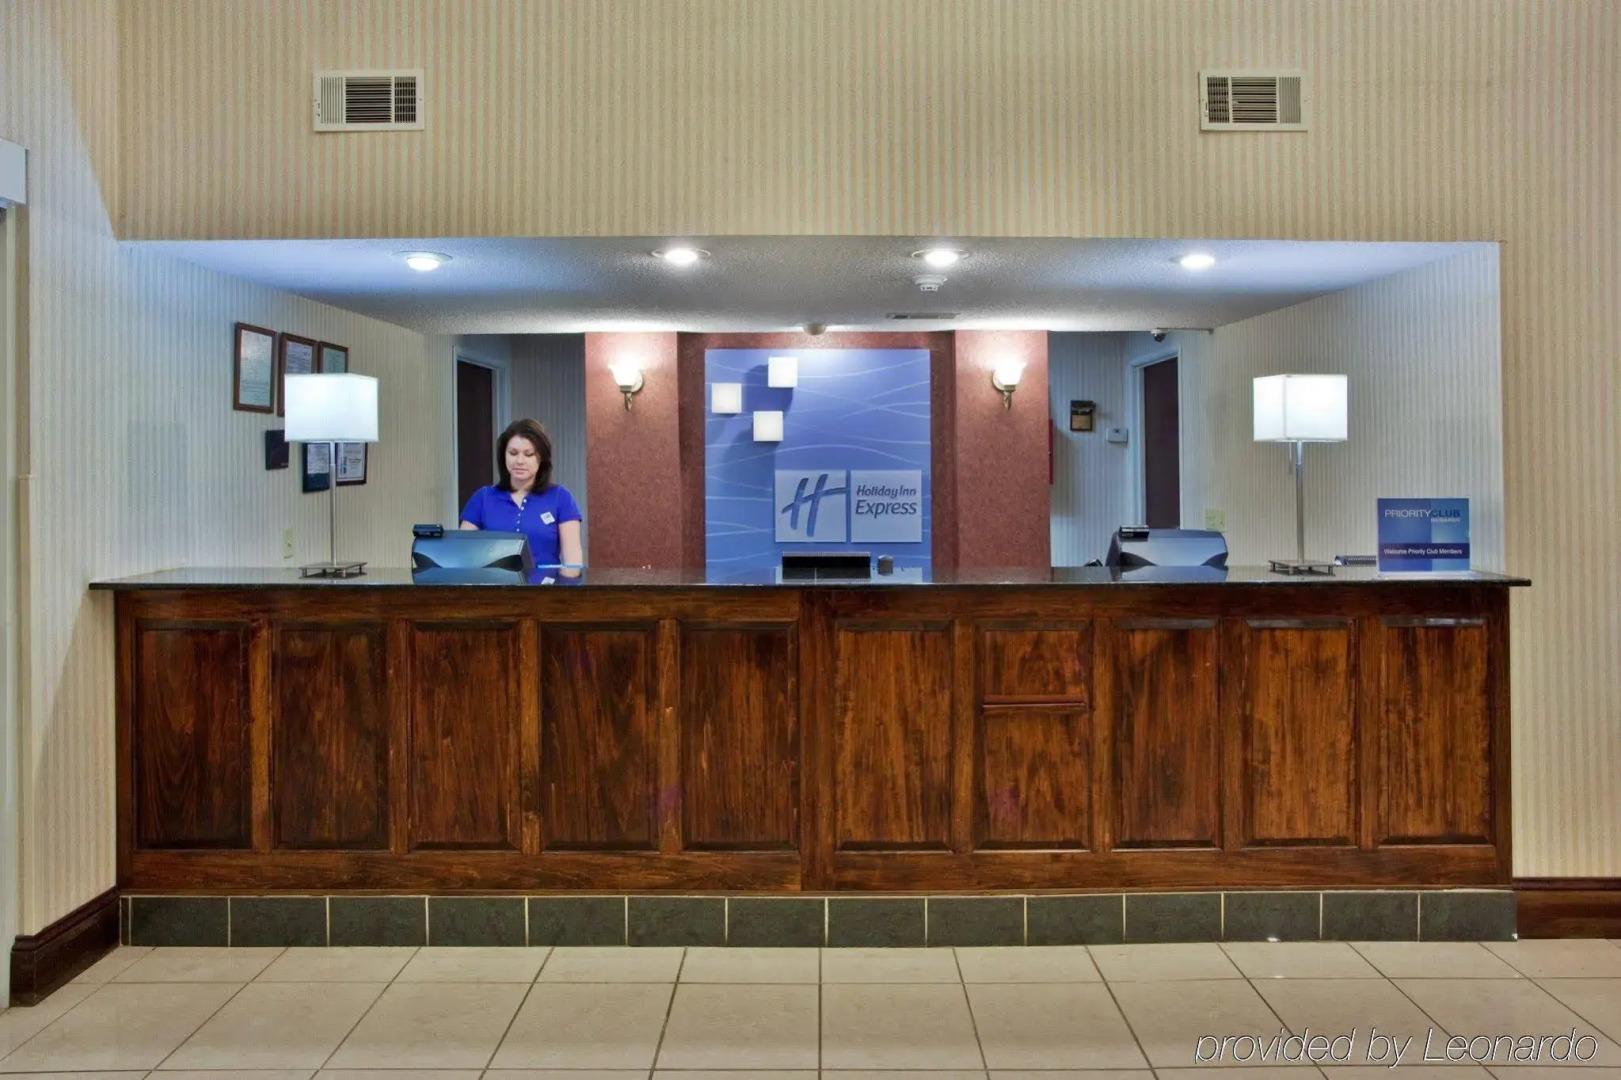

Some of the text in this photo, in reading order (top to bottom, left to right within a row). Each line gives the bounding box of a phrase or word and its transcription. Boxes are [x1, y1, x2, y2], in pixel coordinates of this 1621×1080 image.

[856, 485, 917, 498] Holiday Inn
[855, 499, 917, 519] Express
[1407, 548, 1426, 556] Priority
